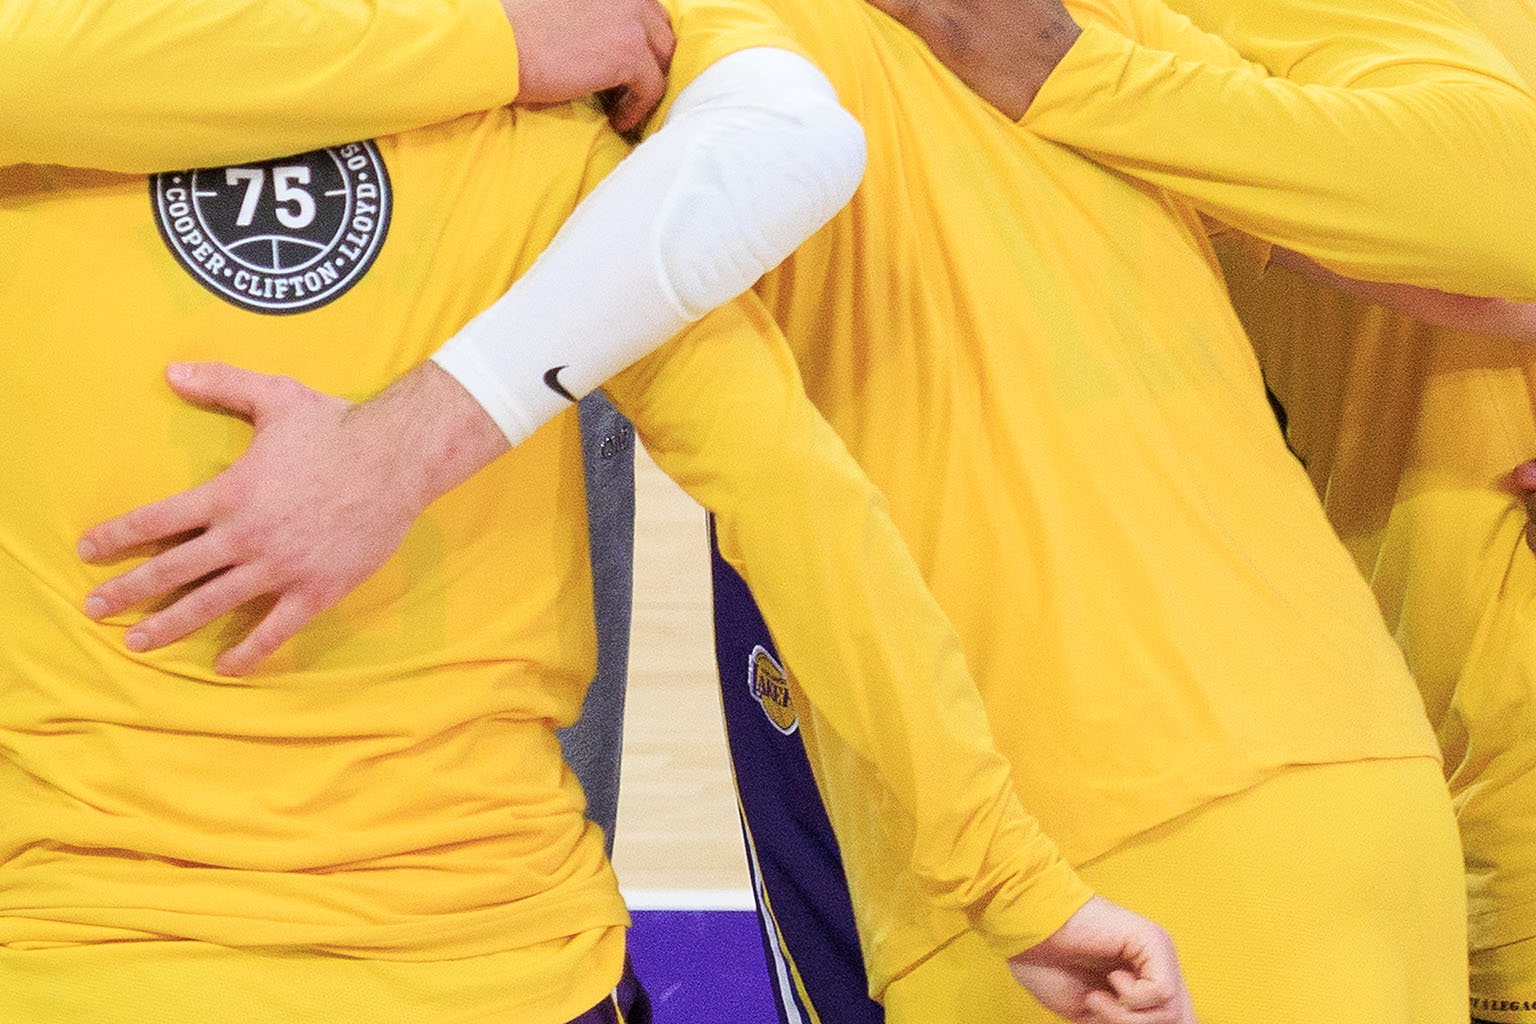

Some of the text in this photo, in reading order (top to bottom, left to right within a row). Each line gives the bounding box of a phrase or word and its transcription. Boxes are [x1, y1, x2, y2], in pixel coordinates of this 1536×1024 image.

[165, 182, 378, 299] COOPER CLIFTON LLOYD
[225, 165, 317, 230] 75
